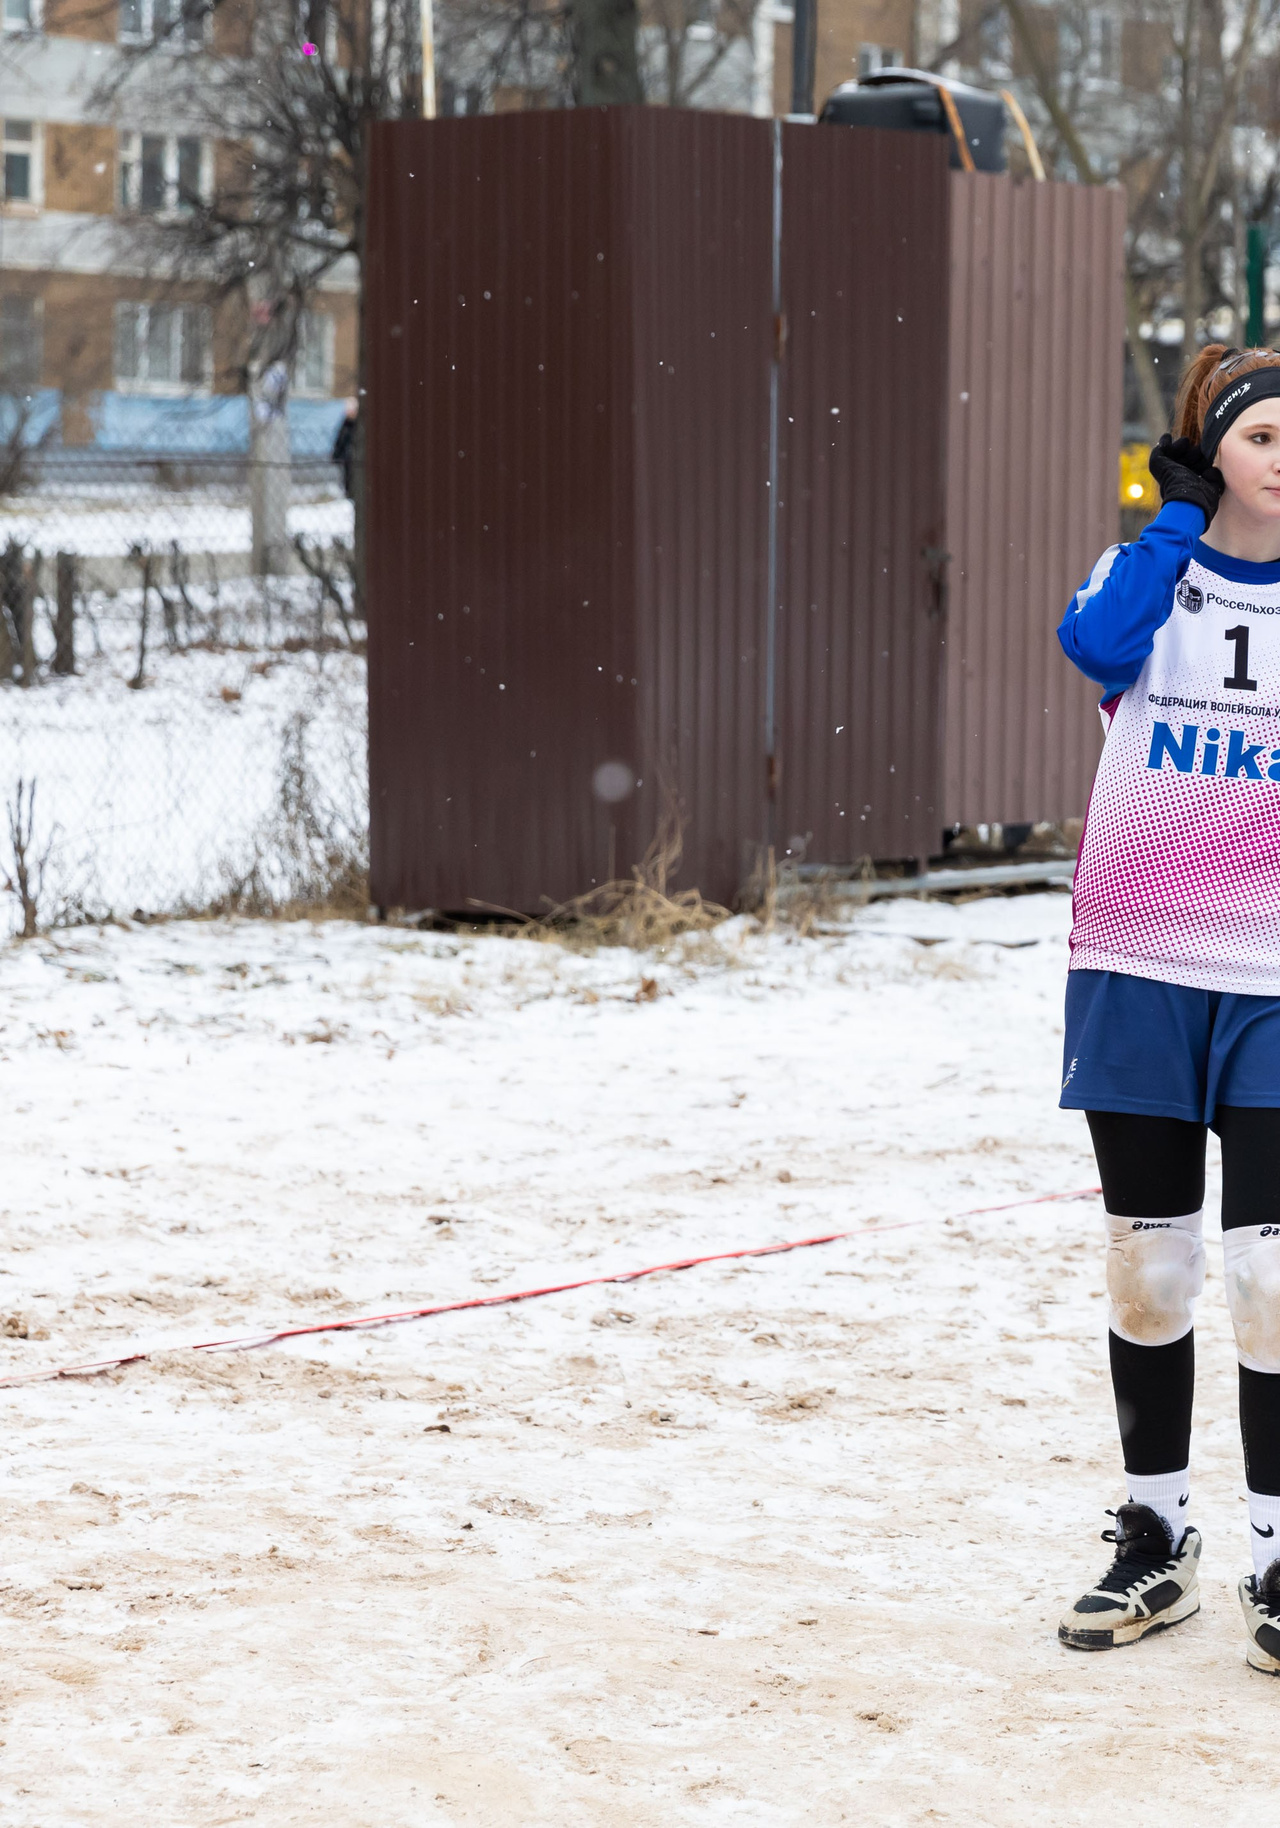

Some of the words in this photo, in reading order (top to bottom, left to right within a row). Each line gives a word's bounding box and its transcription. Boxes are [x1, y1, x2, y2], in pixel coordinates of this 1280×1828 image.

[1223, 624, 1257, 691] 1
[1148, 693, 1207, 710] ФЕДЕРАЦИЯ
[1210, 701, 1272, 717] ВОЛЕЙБОЛА
